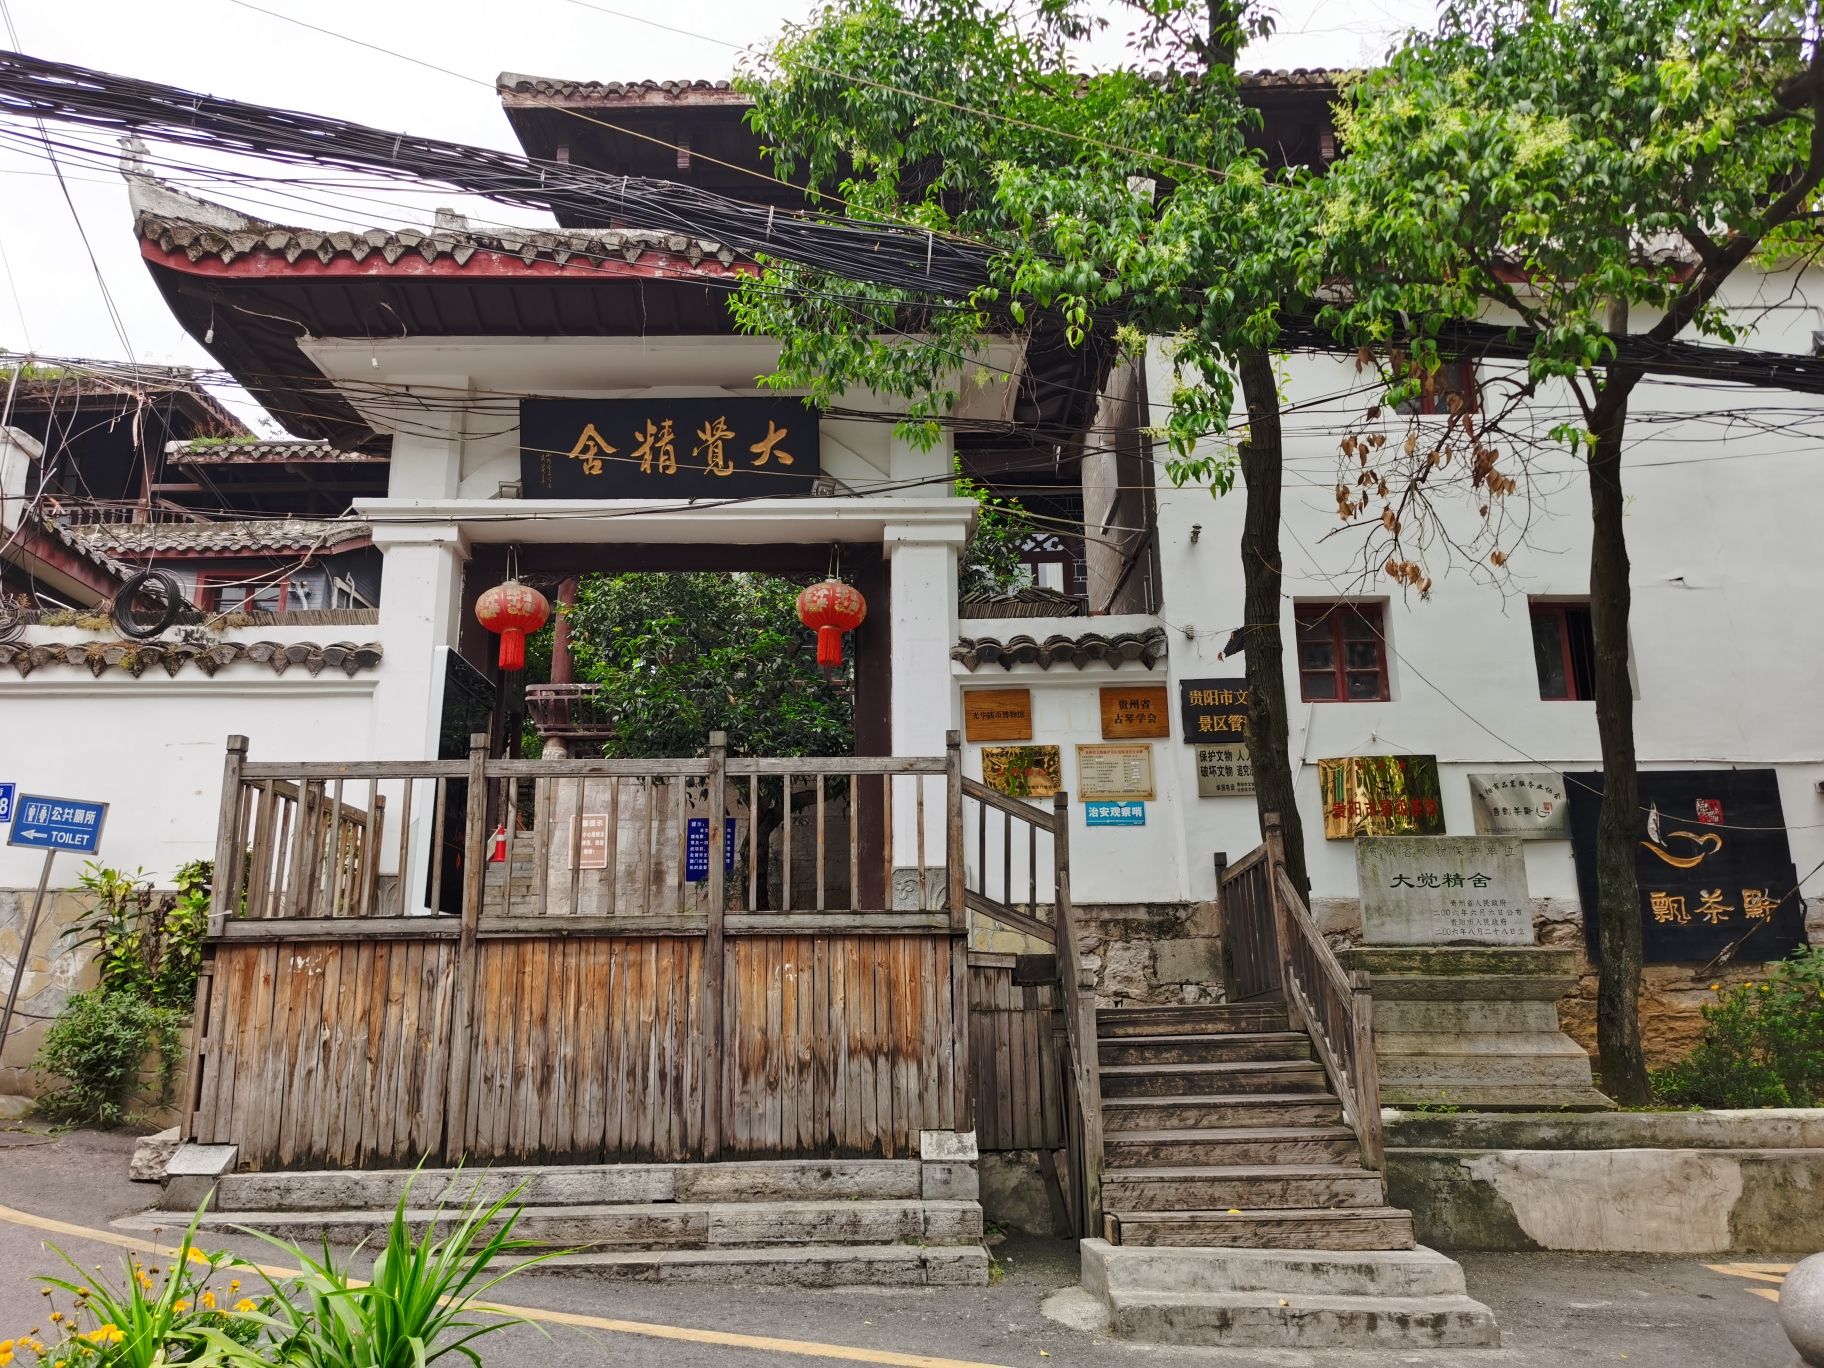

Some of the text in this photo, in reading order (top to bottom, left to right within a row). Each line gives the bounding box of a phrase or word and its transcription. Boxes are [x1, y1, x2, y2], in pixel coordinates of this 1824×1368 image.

[1119, 697, 1151, 710] 贵州省
[1189, 688, 1249, 706] 贵阳市文
[1114, 712, 1158, 725] 古琴学会
[1199, 749, 1233, 762] 保护文物
[1200, 765, 1234, 778] 破坏文物
[51, 806, 97, 825] 公共厕所
[1088, 806, 1143, 818] 治安观察哨
[51, 831, 90, 846] TOILET
[1390, 872, 1493, 889] 大觉精舍
